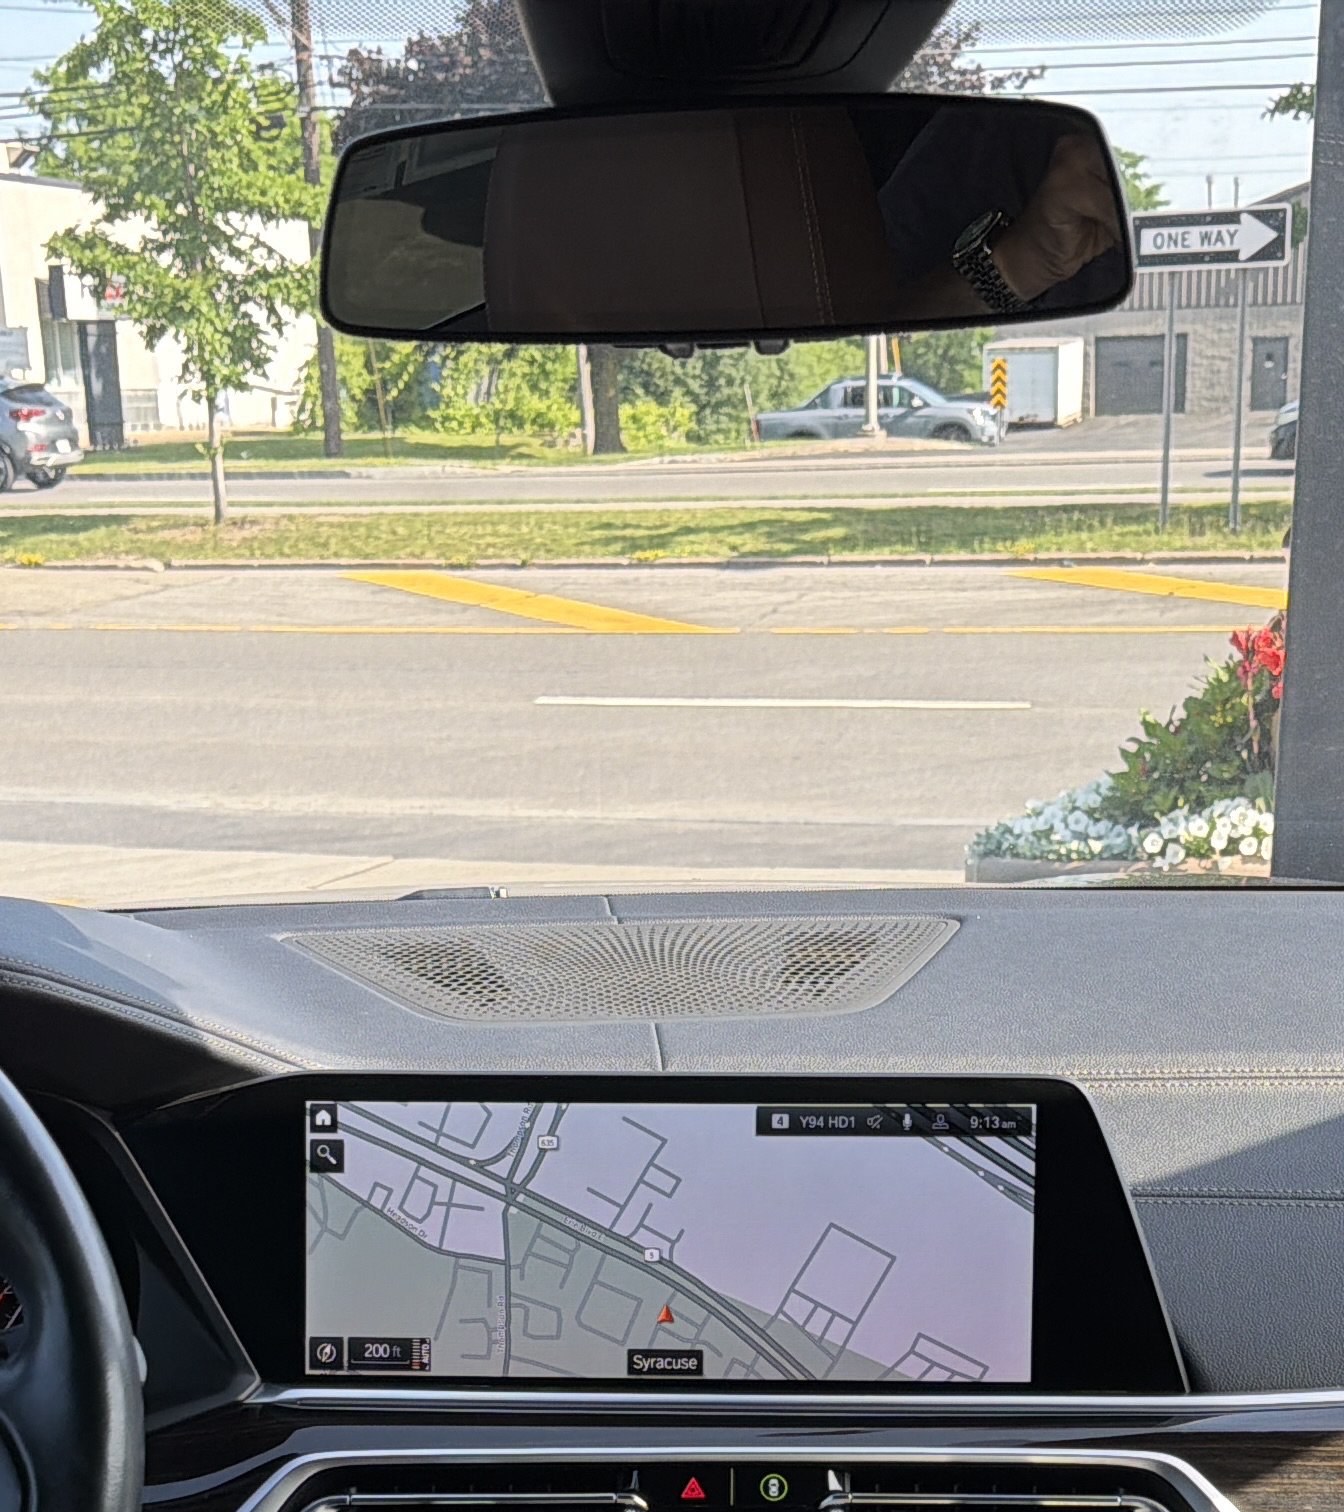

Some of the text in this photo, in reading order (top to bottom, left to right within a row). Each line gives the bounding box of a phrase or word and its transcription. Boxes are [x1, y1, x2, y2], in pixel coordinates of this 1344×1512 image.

[1152, 228, 1239, 250] ONE WAY
[800, 1115, 855, 1128] Y94 HD1
[364, 1343, 401, 1358] 200 ft
[632, 1354, 698, 1372] Syracuse
